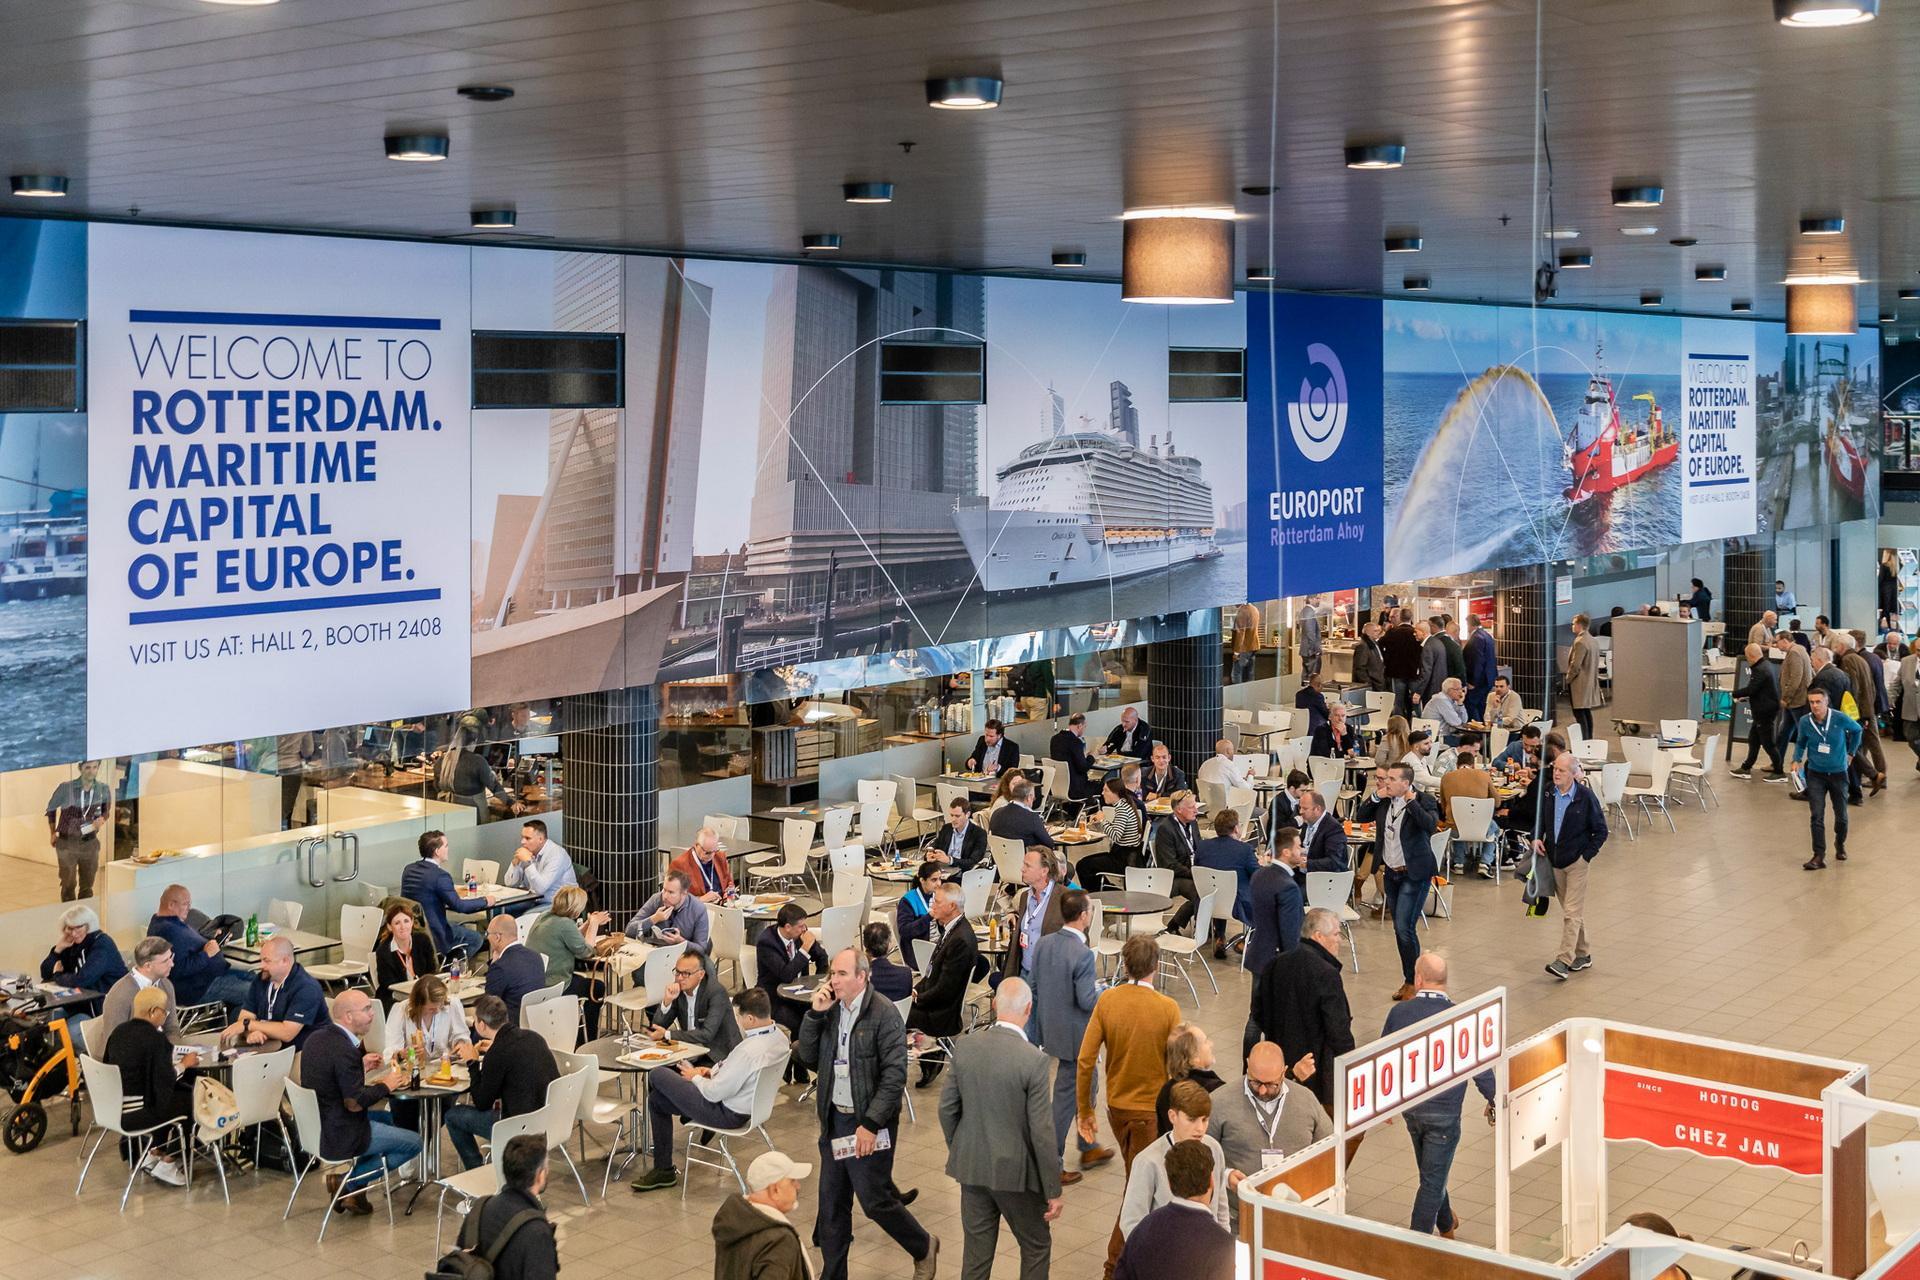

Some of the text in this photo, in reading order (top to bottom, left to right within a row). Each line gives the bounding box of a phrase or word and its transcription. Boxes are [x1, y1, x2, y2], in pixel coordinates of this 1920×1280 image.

[128, 333, 432, 381] WELCOME TO
[132, 389, 442, 435] ROTTERDAM.
[1689, 387, 1749, 407] ROTTERDAM.
[1688, 410, 1736, 430] MARITIME
[1688, 433, 1728, 454] CAPITAL
[128, 440, 377, 490] MARITIME
[1689, 455, 1745, 477] OF EUROPE.
[128, 493, 332, 545] CAPITAL
[1269, 486, 1365, 521] EUROPORT
[1270, 521, 1365, 546] Rotterdam Ahoy
[128, 539, 415, 600] OF EUROPE.
[129, 618, 442, 665] VISIT US AT: HALL 2, BOOTH 2408
[1353, 1016, 1494, 1110] HOTDOG
[1699, 1090, 1760, 1112] HOTDOG
[1675, 1124, 1780, 1159] CHEZ JAN
